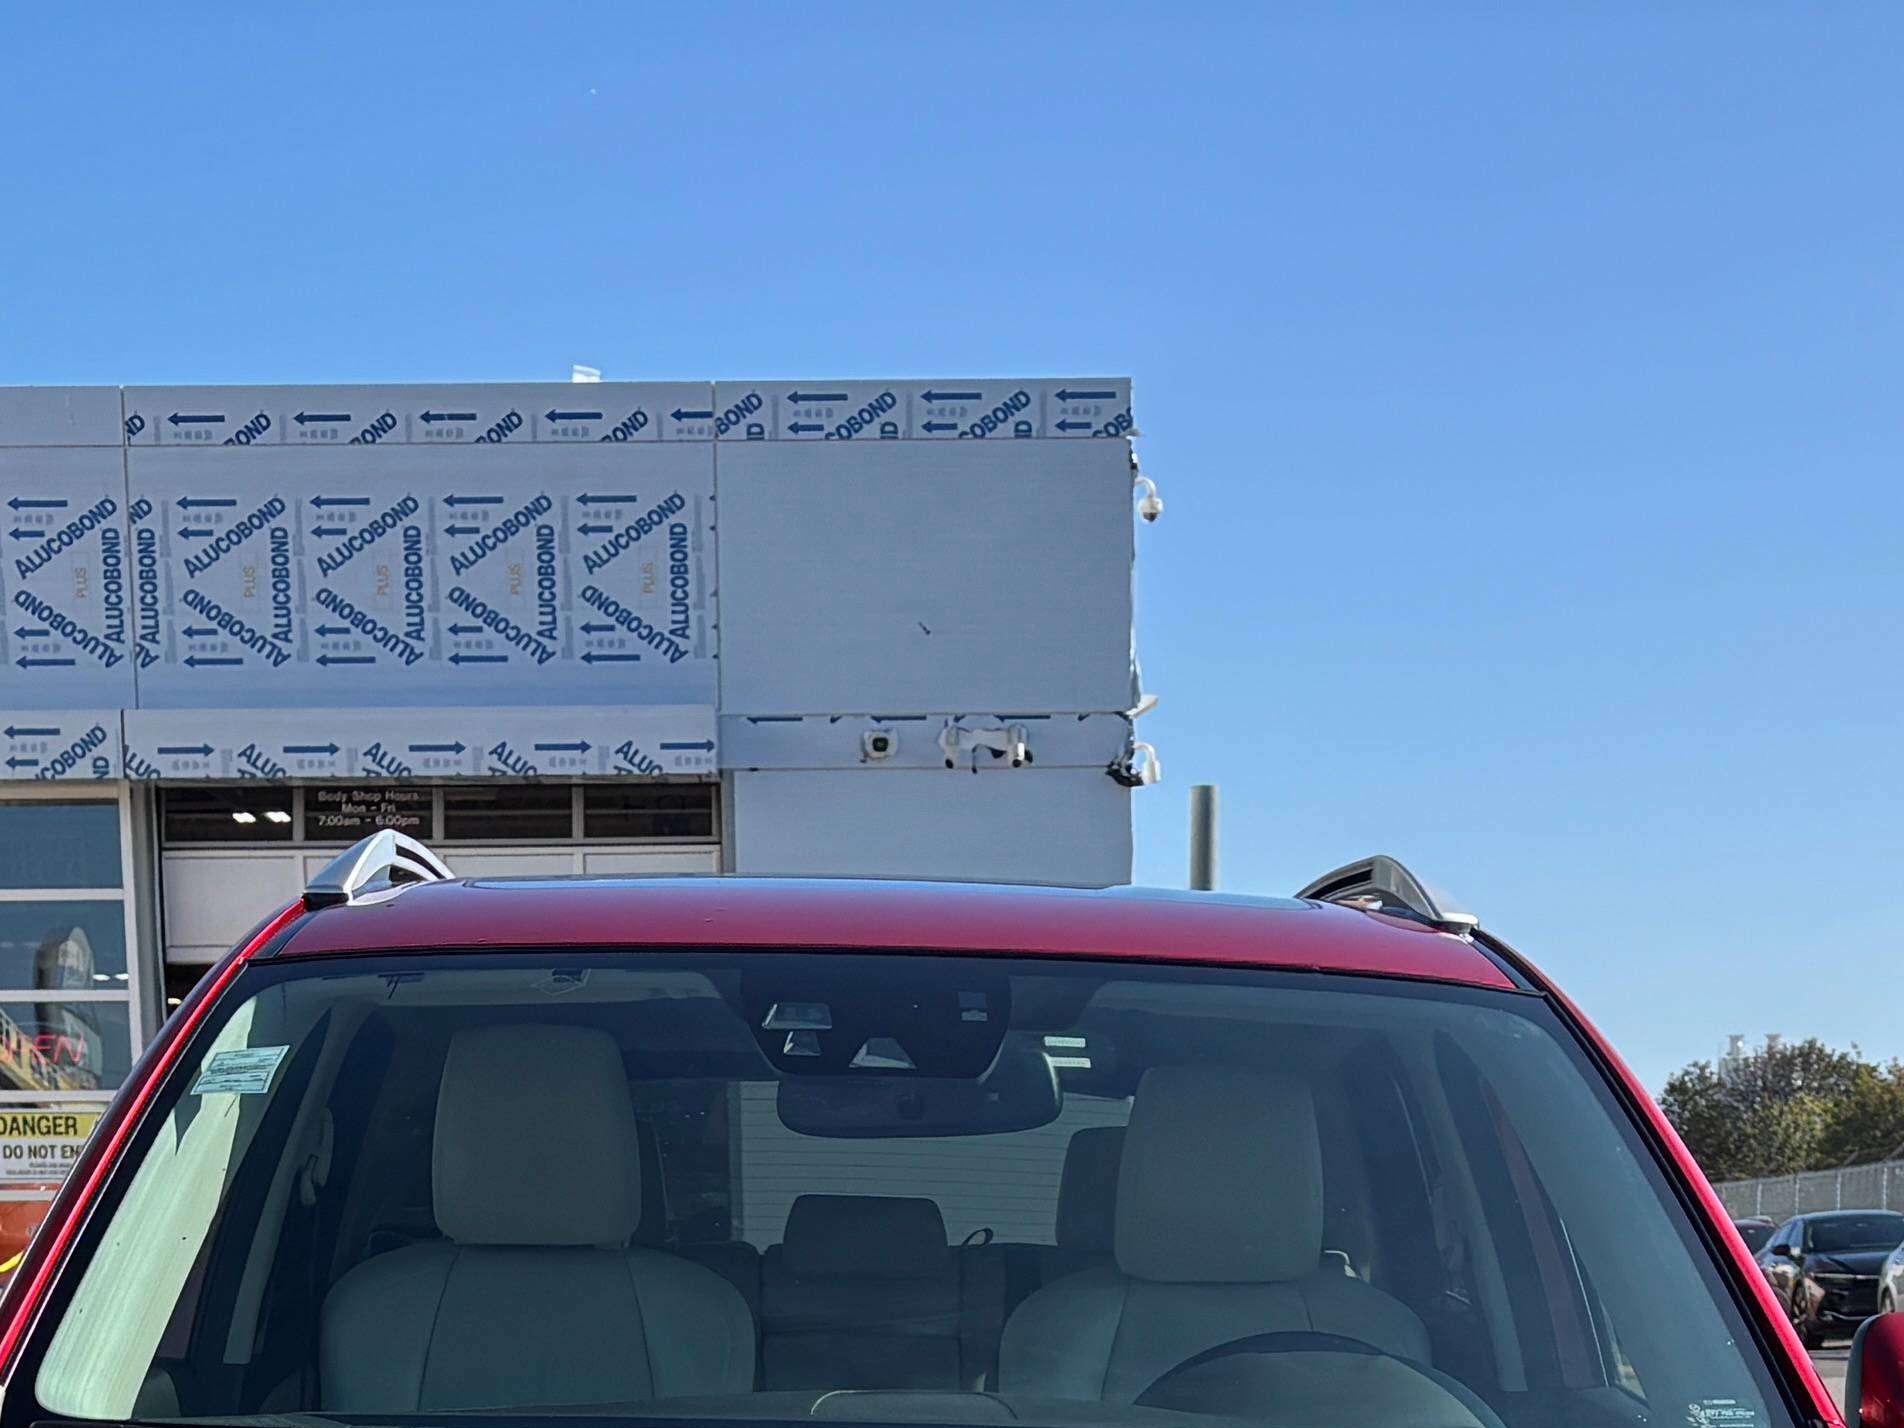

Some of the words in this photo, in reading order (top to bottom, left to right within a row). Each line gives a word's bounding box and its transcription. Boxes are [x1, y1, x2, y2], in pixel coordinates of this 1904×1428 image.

[15, 497, 118, 579] ALUCOBOND
[183, 497, 286, 579] ALUCOBOND
[316, 495, 419, 578] ALUCOBOND
[449, 494, 552, 576] ALUCOBOND
[582, 493, 686, 574] ALUCOBOND
[101, 527, 125, 644] ALUCOBOND
[137, 527, 160, 644] ALUCOBOND
[270, 526, 293, 643] ALUCOBOND
[403, 525, 425, 641] ALUCOBOND
[536, 524, 558, 640] ALUCOBOND
[669, 522, 690, 639] ALUCOBOND
[14, 590, 124, 668] ALUCOBOND
[183, 589, 291, 667] ALUCOBOND
[315, 588, 424, 666] ALUCOBOND
[448, 586, 556, 664] ALUCOBOND
[581, 585, 689, 663] ALUCOBOND
[342, 802, 366, 813] Mon
[381, 802, 396, 813] Fri
[3, 1144, 24, 1159] DO
[27, 1144, 58, 1159] NOT
